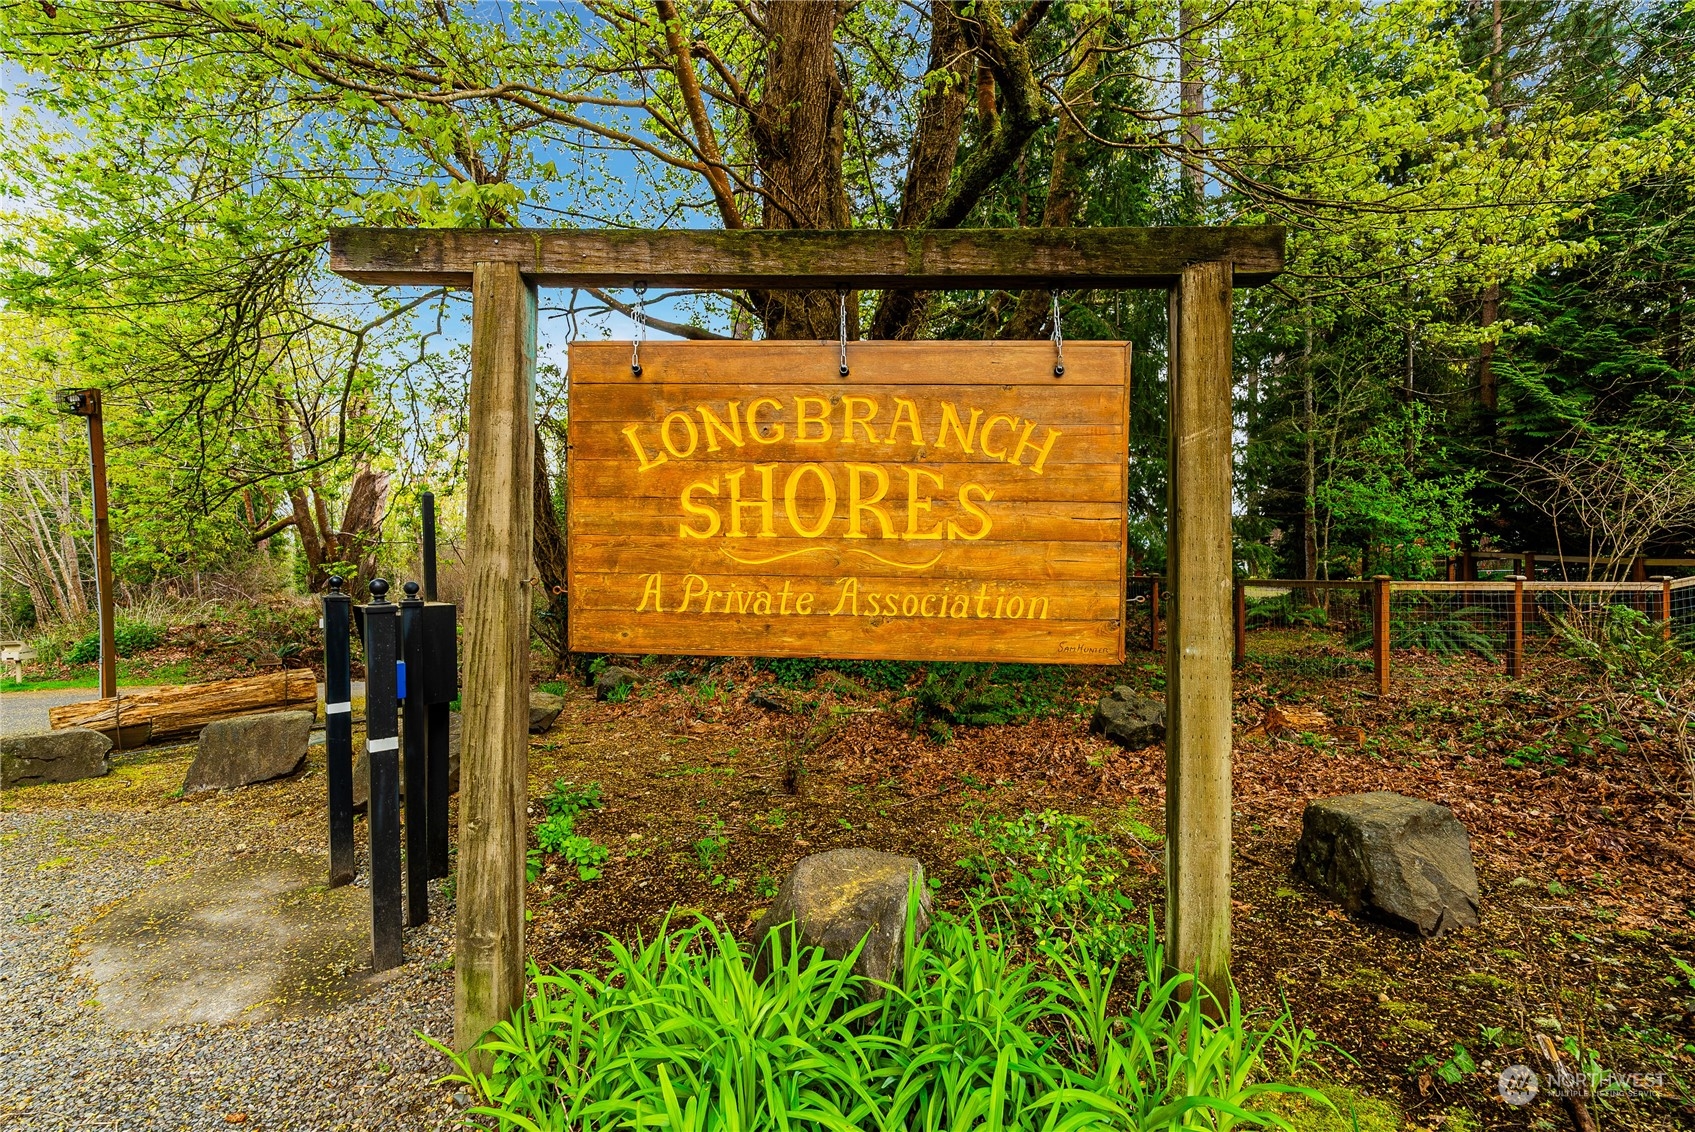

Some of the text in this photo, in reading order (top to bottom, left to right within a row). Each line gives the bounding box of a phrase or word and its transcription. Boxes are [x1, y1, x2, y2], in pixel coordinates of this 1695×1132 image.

[622, 395, 1062, 475] LONGBRANCH
[680, 462, 996, 541] SHORES
[636, 573, 1050, 620] A Private Association
